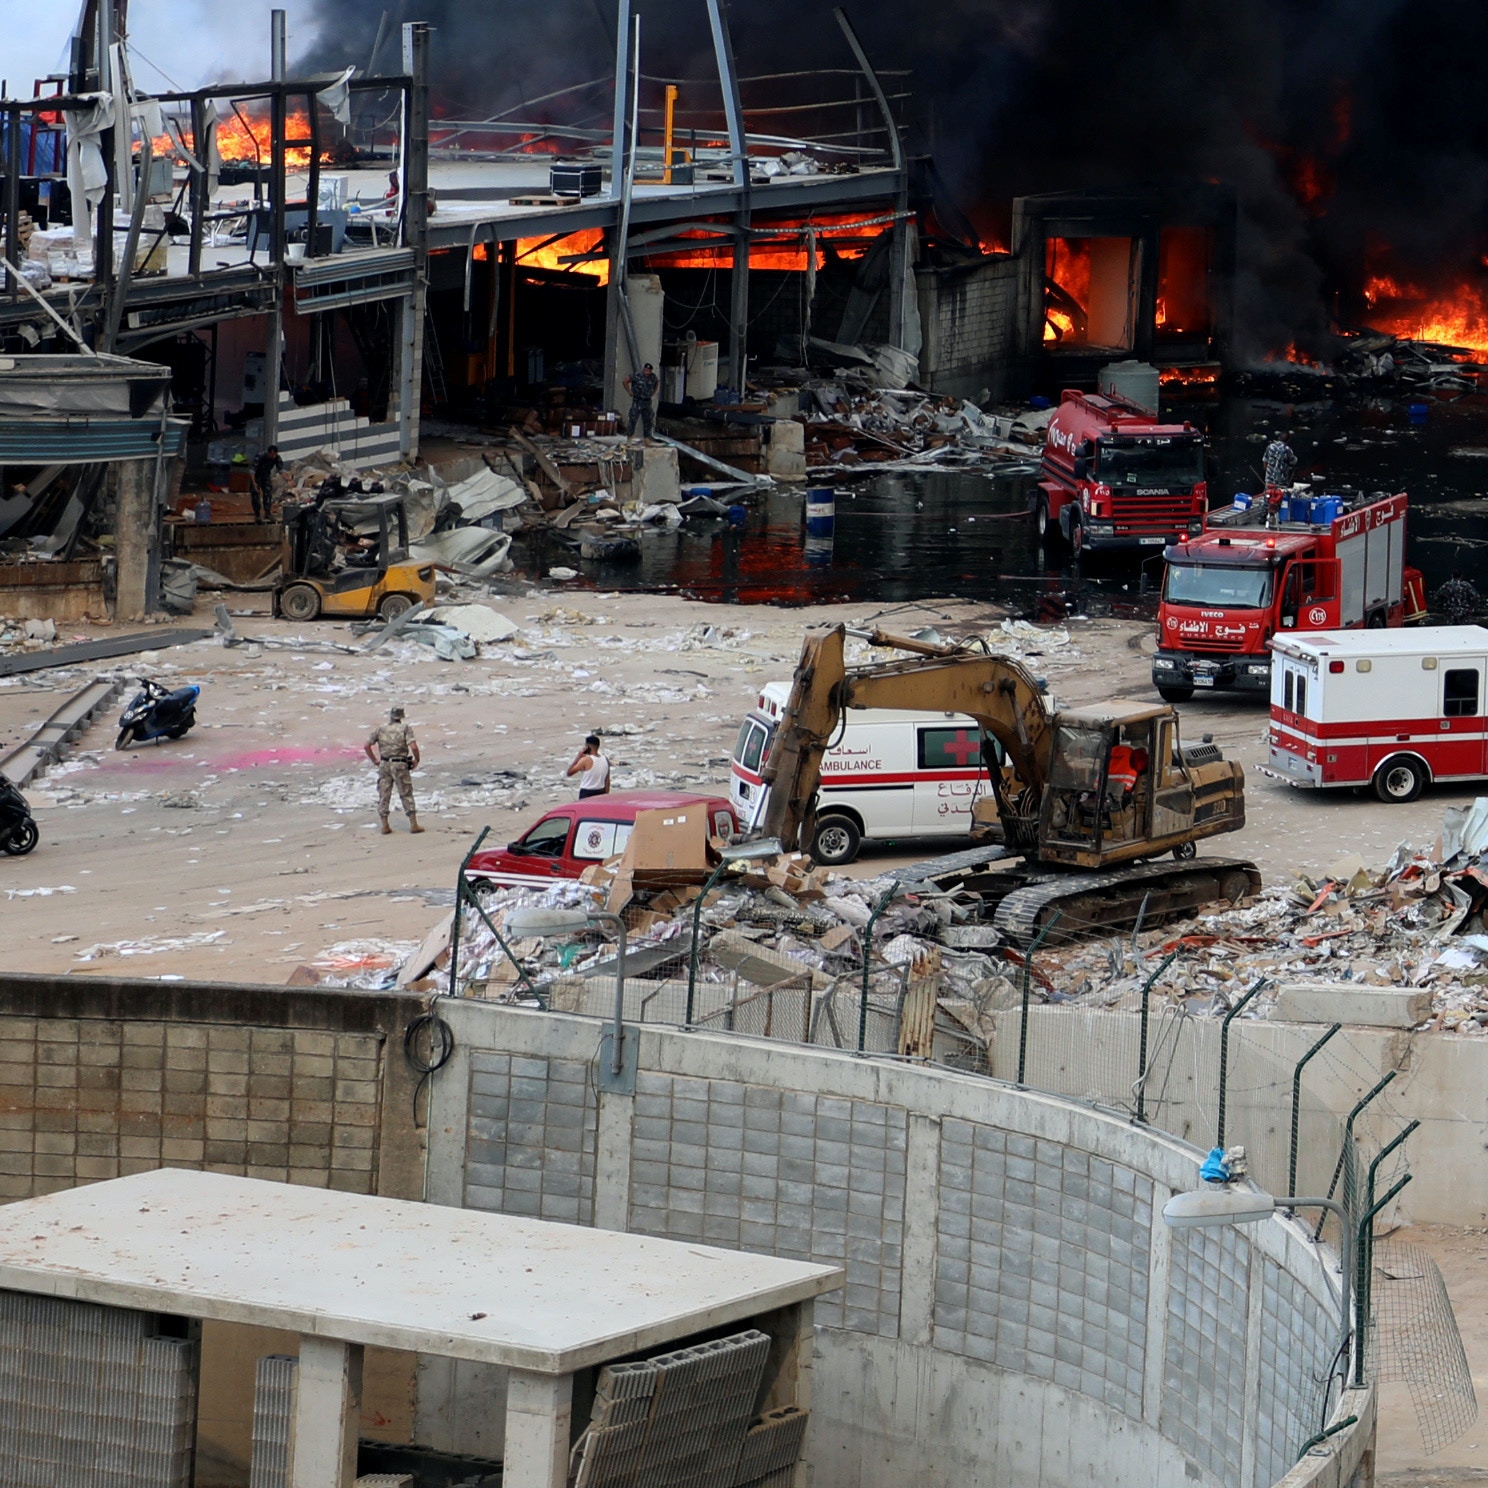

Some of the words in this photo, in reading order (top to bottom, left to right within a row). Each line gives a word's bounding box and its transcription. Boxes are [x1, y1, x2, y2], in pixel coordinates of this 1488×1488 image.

[1137, 488, 1170, 496] SCANIA
[1201, 610, 1225, 618] IVECO
[1179, 620, 1209, 633] الاطفاء
[1215, 623, 1246, 636] فوج
[828, 743, 872, 756] اسعاف
[818, 759, 882, 772] AMBULANCE
[937, 782, 987, 798] الدفاع
